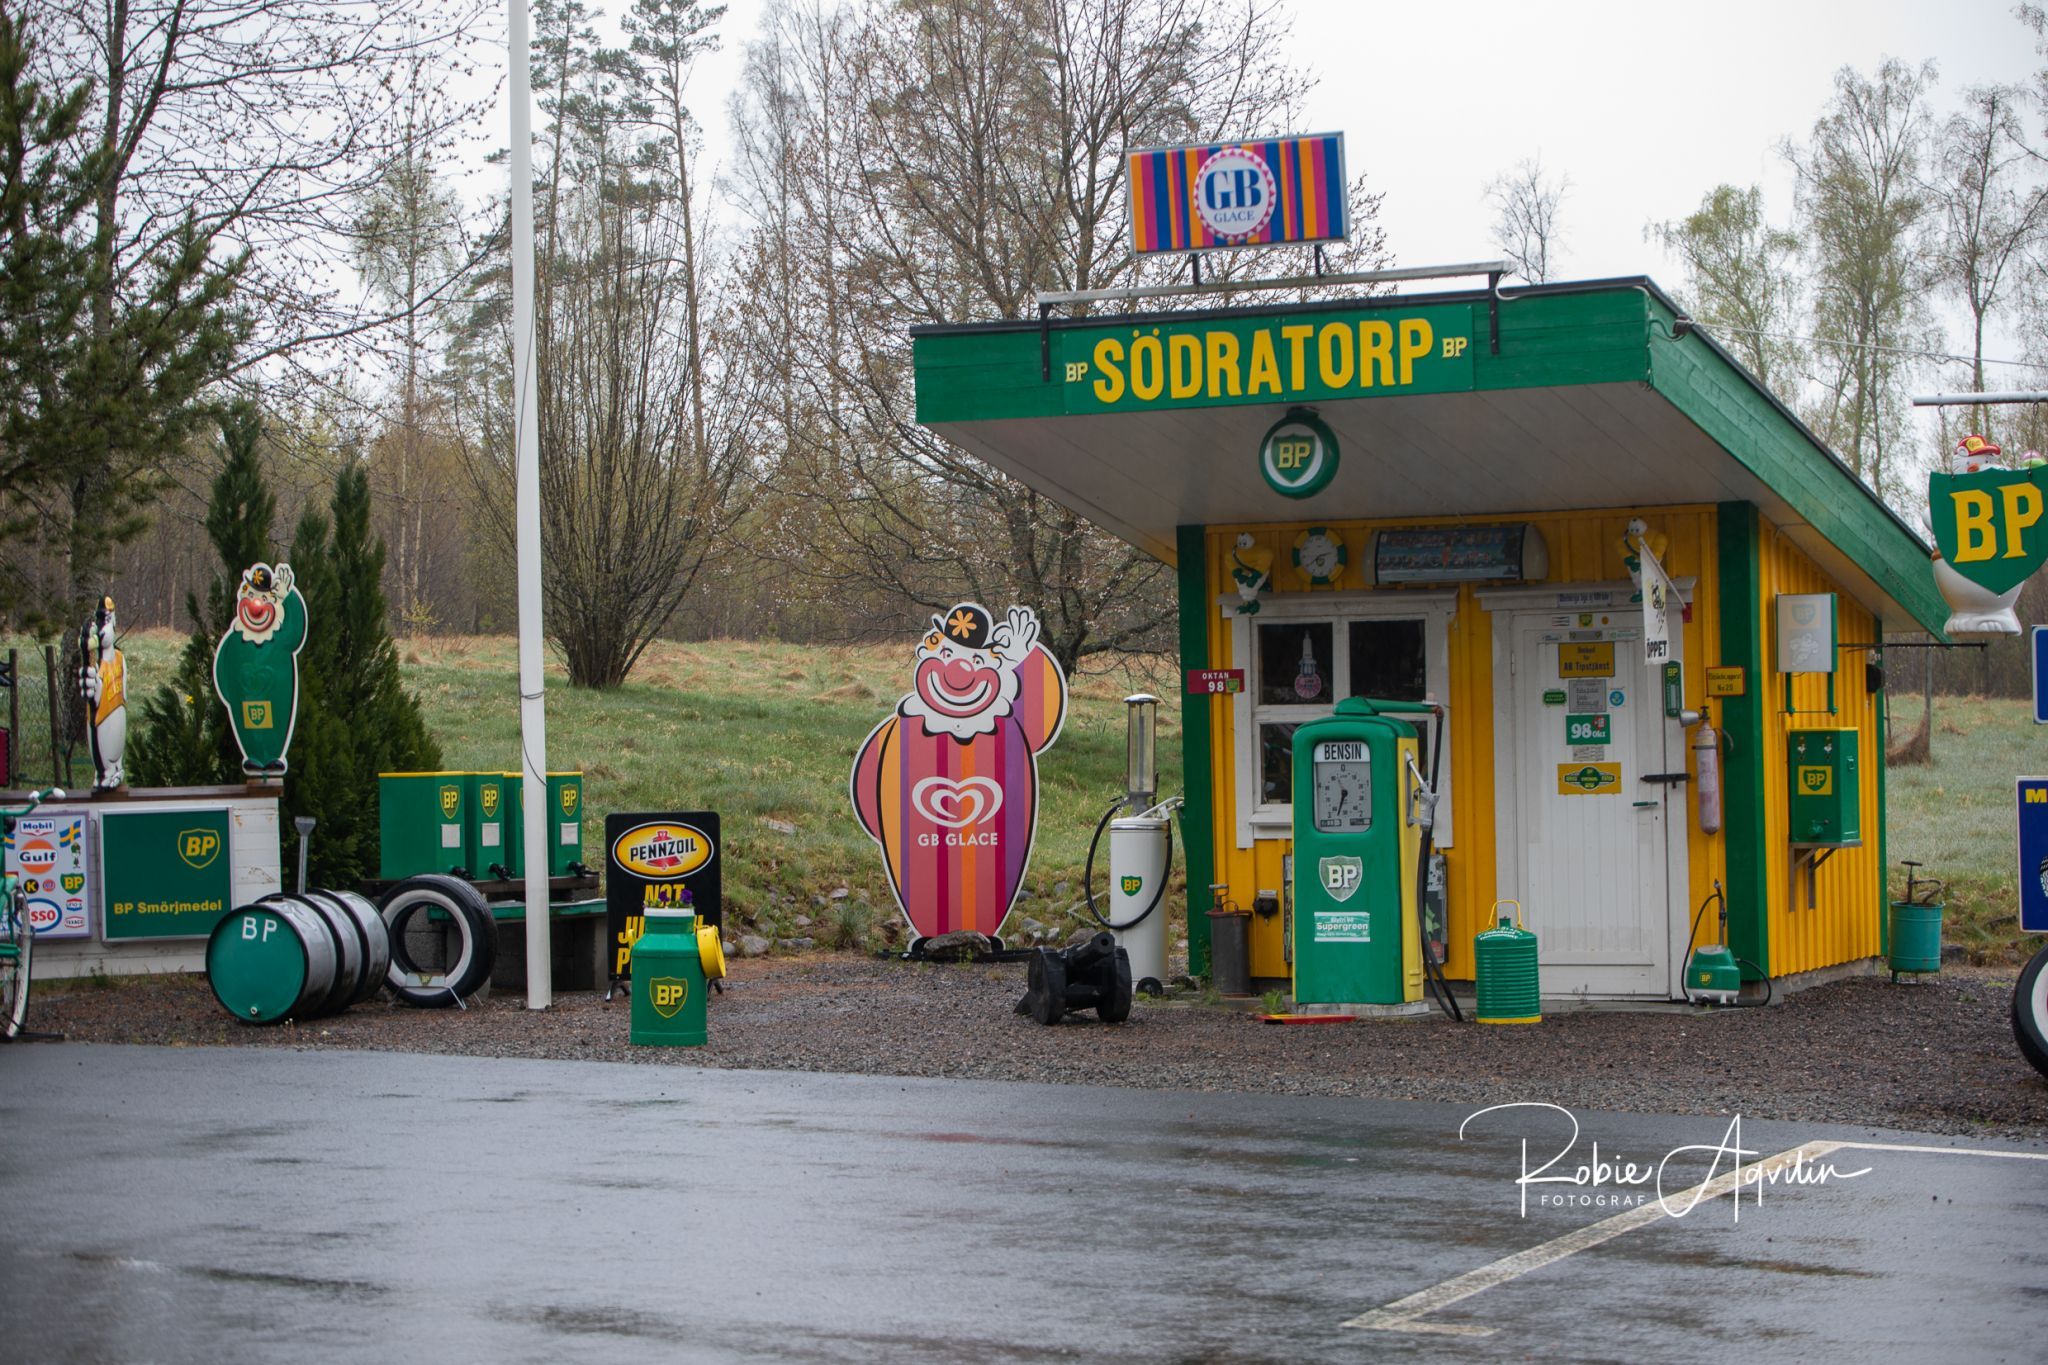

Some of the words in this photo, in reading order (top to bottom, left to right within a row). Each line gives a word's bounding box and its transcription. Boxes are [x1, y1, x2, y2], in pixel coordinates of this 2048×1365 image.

[1205, 168, 1262, 210] GB
[1214, 211, 1255, 223] GLACE
[1066, 362, 1088, 382] BP
[1093, 317, 1434, 403] SÖDRATORP
[1442, 337, 1467, 358] BP
[1278, 442, 1310, 468] BP
[1950, 481, 2044, 563] BP
[1202, 672, 1229, 680] OKTAN
[1208, 681, 1225, 692] 98
[250, 707, 264, 721] BP
[1571, 723, 1592, 739] 98
[1324, 743, 1362, 760] BENSIN
[1807, 773, 1825, 787] BP
[443, 791, 457, 809] BP
[484, 790, 496, 807] BP
[563, 790, 576, 807] BP
[22, 822, 53, 831] Mobil
[185, 836, 216, 857] BP
[918, 832, 939, 847] GB
[945, 831, 998, 847] GLACE
[19, 851, 56, 862] Gulf
[630, 838, 698, 862] PENNZOIL
[64, 876, 83, 889] BP
[1327, 864, 1359, 890] BP
[26, 880, 36, 891] K
[1123, 880, 1140, 892] BP
[114, 903, 133, 915] BP
[137, 900, 222, 915] Smörjmedel
[30, 910, 57, 922] SSO
[242, 916, 277, 943] BP
[1316, 922, 1369, 932] Supergreen
[655, 984, 684, 1006] BP
